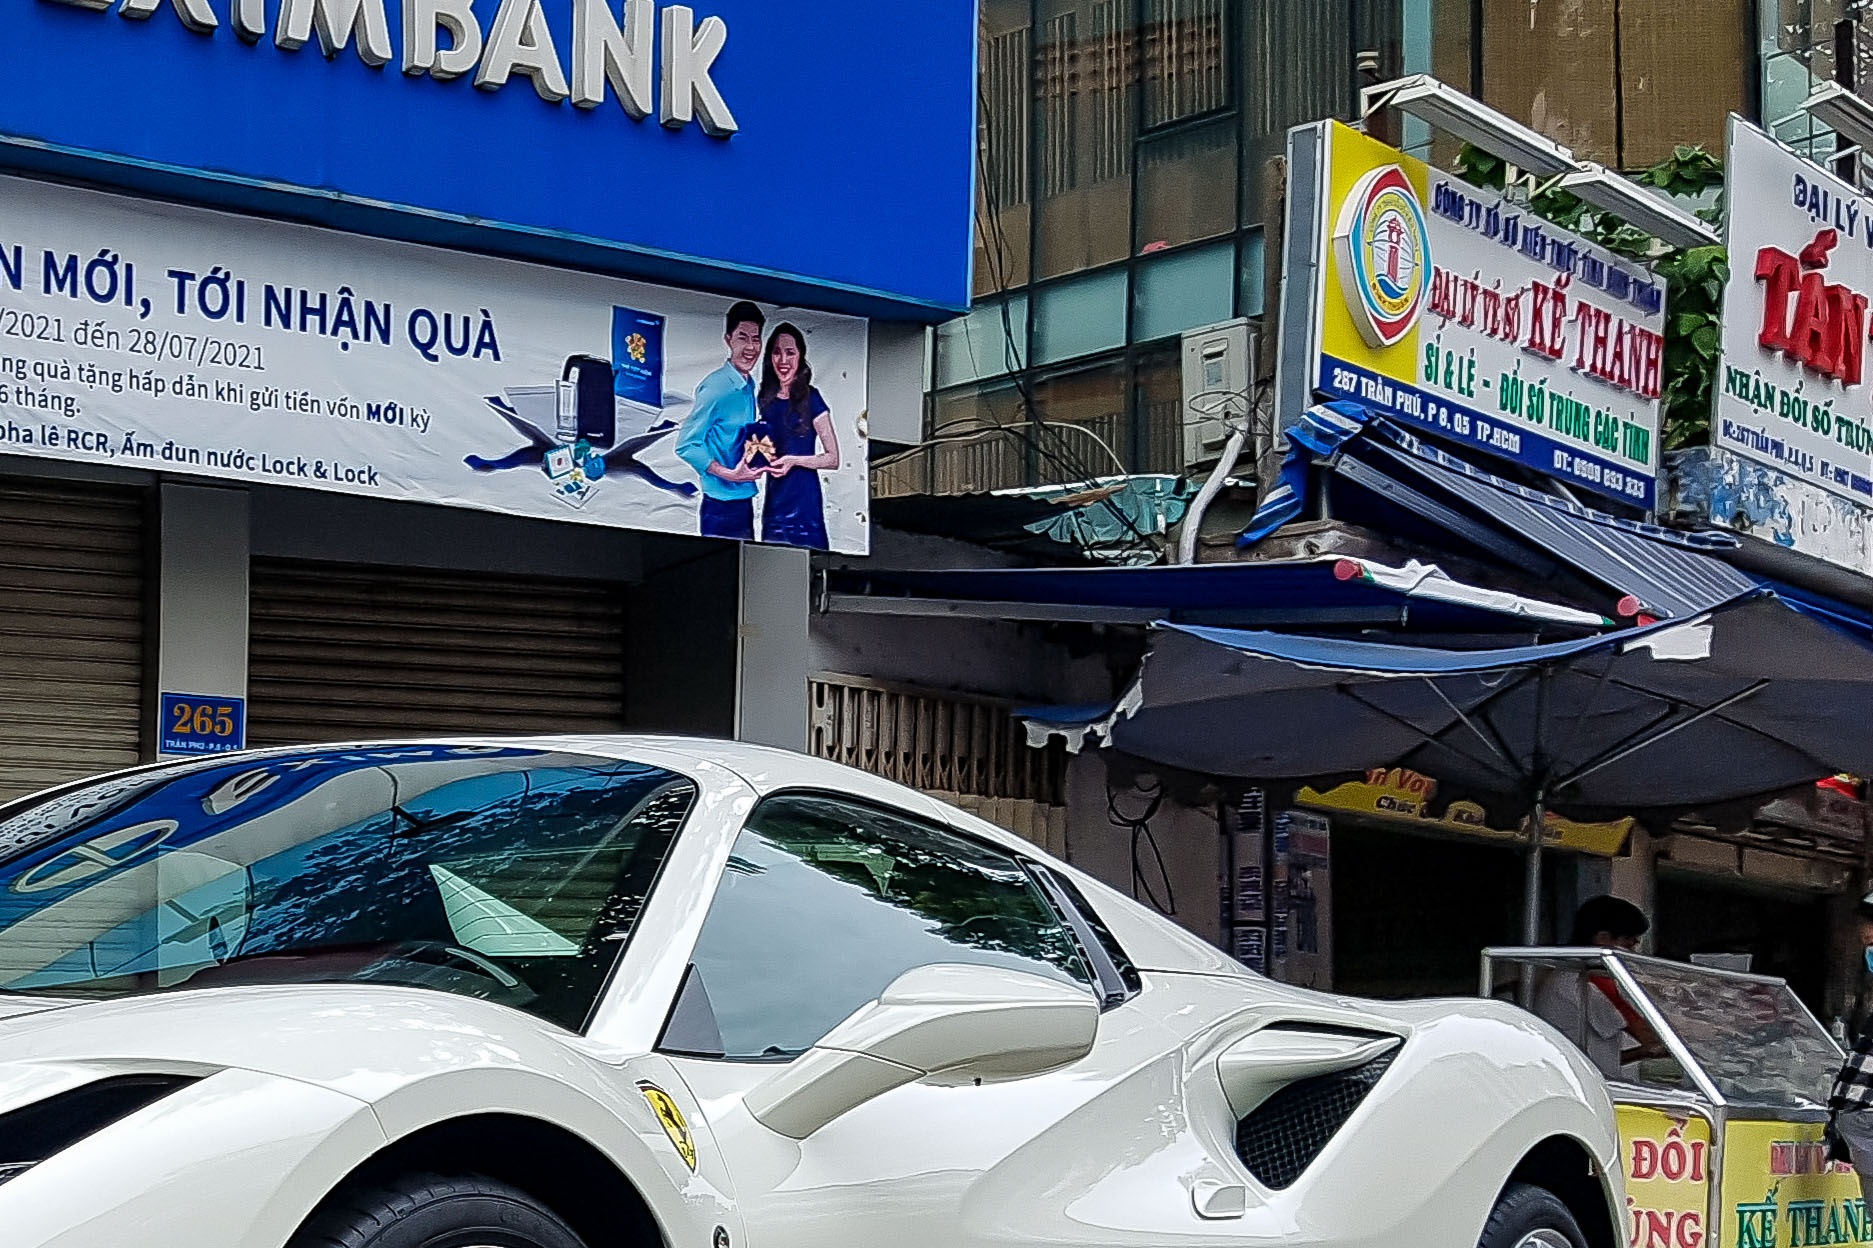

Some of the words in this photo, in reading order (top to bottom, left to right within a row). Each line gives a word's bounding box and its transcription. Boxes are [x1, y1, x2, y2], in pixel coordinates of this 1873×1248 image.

[1793, 173, 1829, 223] ĐẠI
[1834, 197, 1860, 238] LÝ
[42, 247, 152, 321] MỚI,
[167, 265, 247, 324] TỚI
[263, 285, 393, 352] NHẬN
[408, 307, 503, 364] QUÀ
[1429, 264, 1459, 331] ĐẠI
[1574, 298, 1665, 400] THANH
[1754, 227, 1868, 388] TẤN
[73, 319, 120, 351] đến
[128, 328, 265, 371] 28/07/2021
[15, 384, 82, 418] tháng.
[33, 358, 71, 383] quà
[77, 361, 123, 394] tặng
[129, 367, 166, 398] hấp
[171, 374, 209, 400] dẫn
[214, 379, 244, 404] khi
[248, 386, 279, 413] gửi
[326, 396, 360, 420] vốn
[366, 400, 405, 426] MỚI
[410, 407, 432, 434] kỳ
[1360, 376, 1394, 409] TRẦN
[1475, 420, 1522, 454] TP.HCM
[1444, 349, 1456, 391] &
[1457, 347, 1477, 400] LẺ
[1500, 358, 1525, 418] ĐỔI
[1528, 376, 1551, 425] SỐ
[1549, 390, 1591, 444] TRÚNG
[1593, 406, 1620, 454] CÁC
[1622, 410, 1652, 466] TỈNH
[1725, 365, 1777, 415] NHẬN
[1779, 380, 1809, 429] ĐỔI
[1811, 399, 1834, 436] SỐ
[40, 424, 60, 447] lê
[66, 428, 116, 459] RCR,
[121, 430, 155, 459] Ấm
[160, 440, 201, 465] đun
[206, 448, 256, 472] nước
[261, 453, 309, 478] Lock
[312, 460, 329, 480] &
[333, 462, 380, 487] Lock
[171, 703, 234, 736] 265
[1631, 1119, 1705, 1182] ĐỔI
